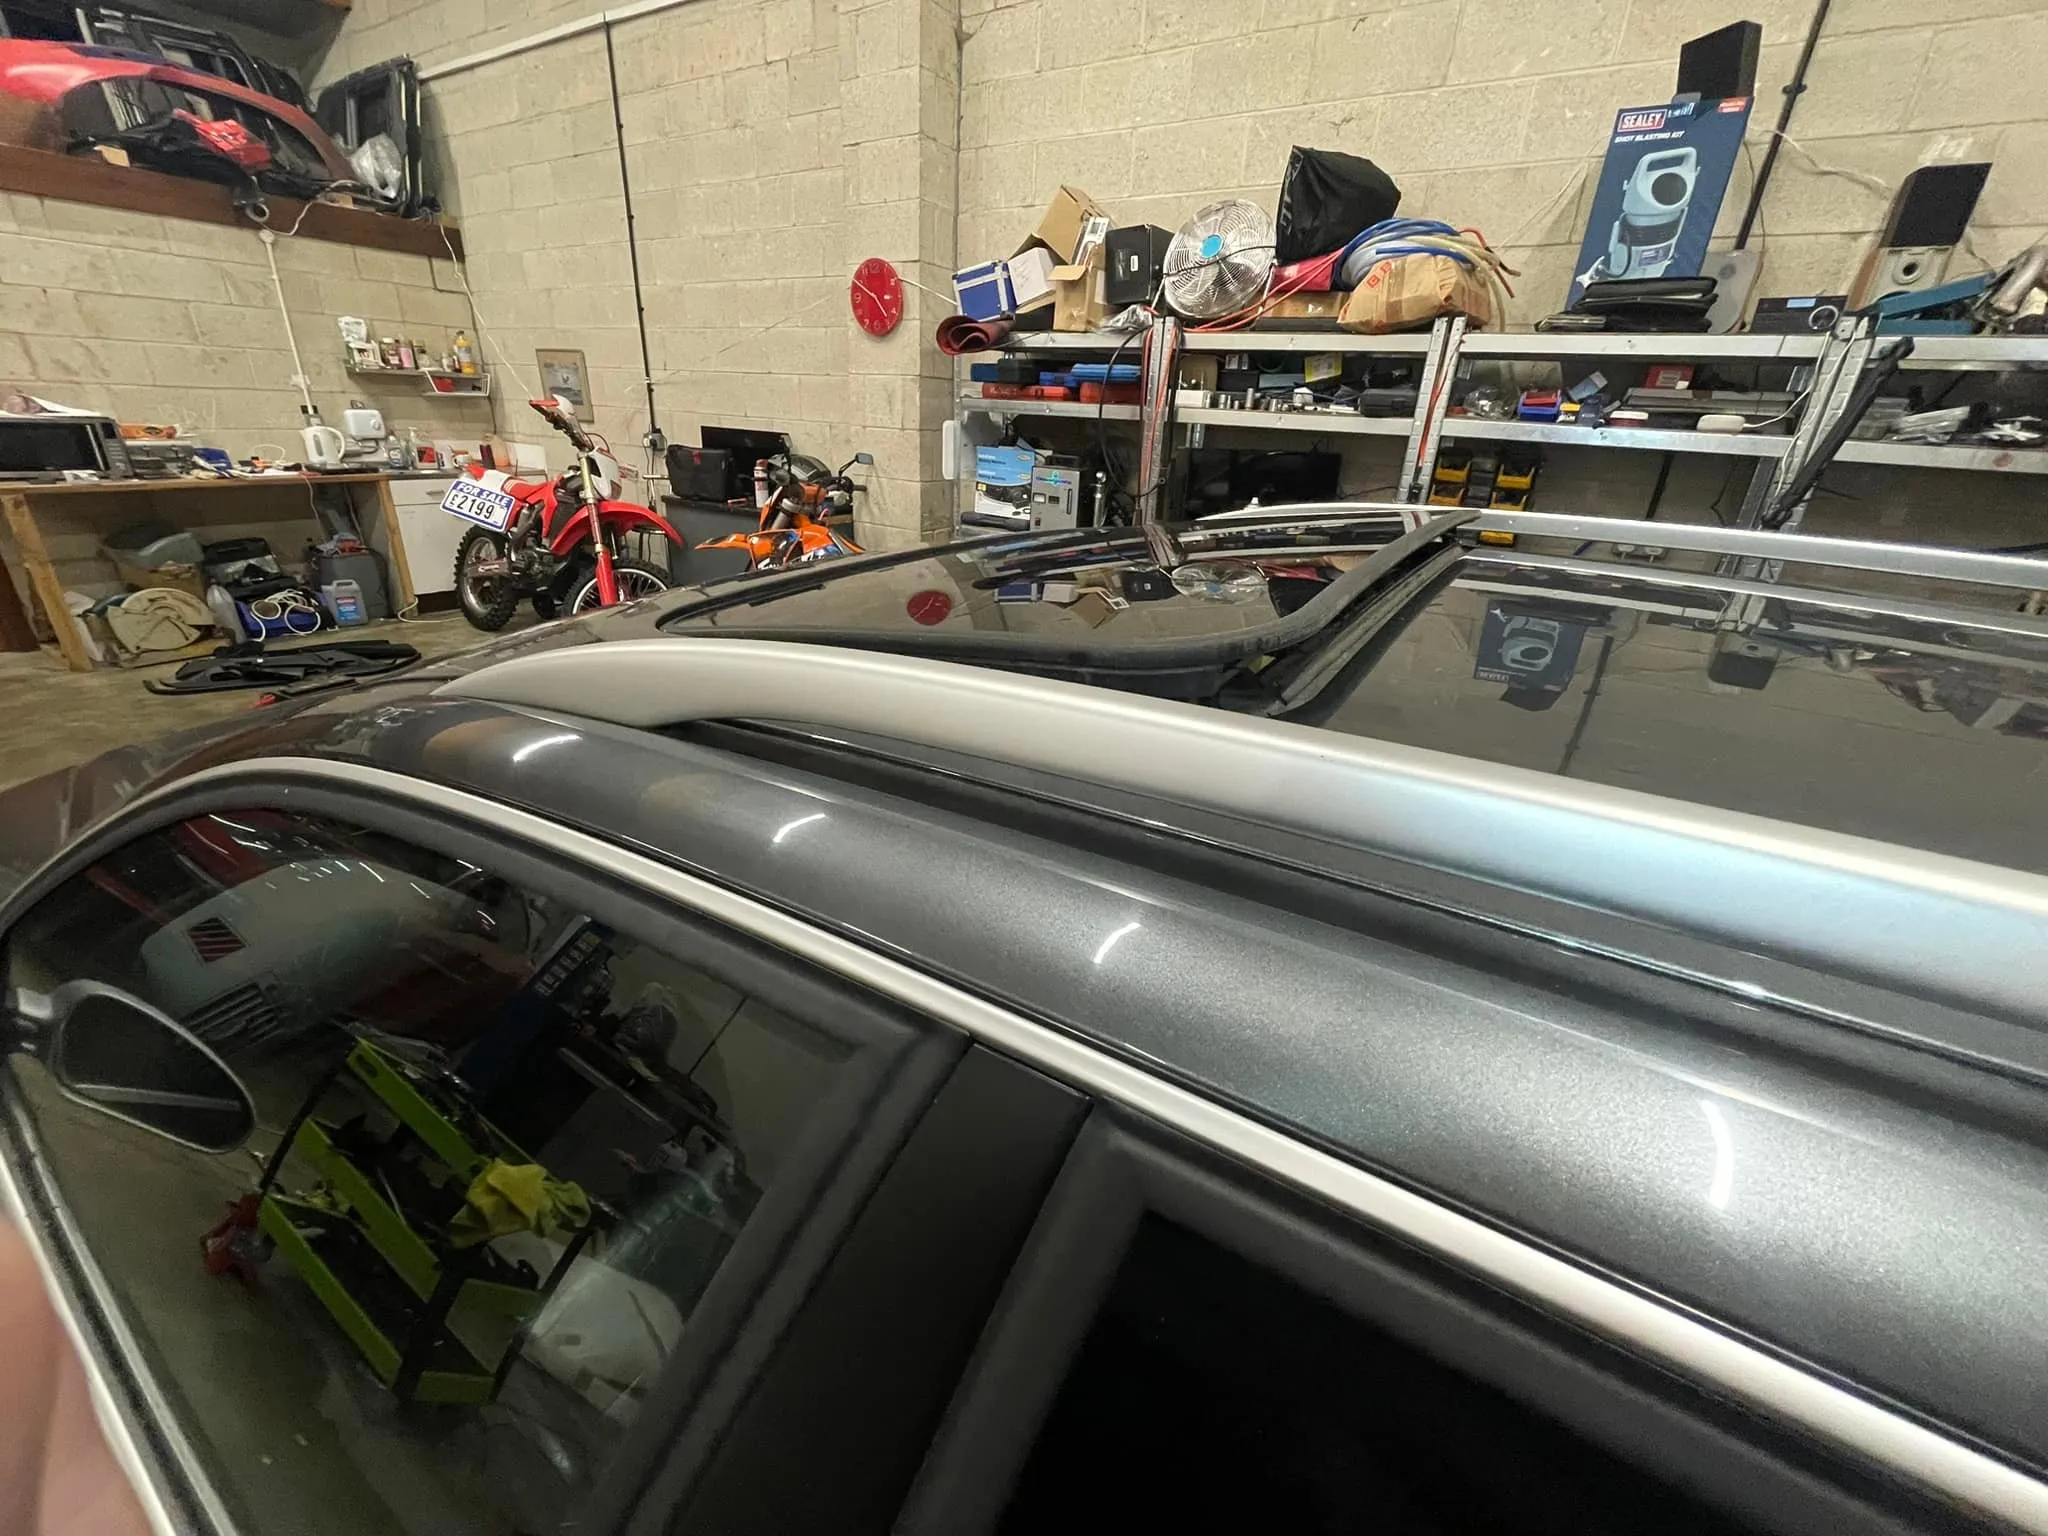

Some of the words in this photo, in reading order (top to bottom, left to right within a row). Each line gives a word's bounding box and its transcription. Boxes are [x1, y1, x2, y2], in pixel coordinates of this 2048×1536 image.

[1622, 112, 1663, 129] SEALEY
[457, 482, 479, 497] FOR
[481, 490, 511, 506] SALE
[450, 494, 495, 519] £2199
